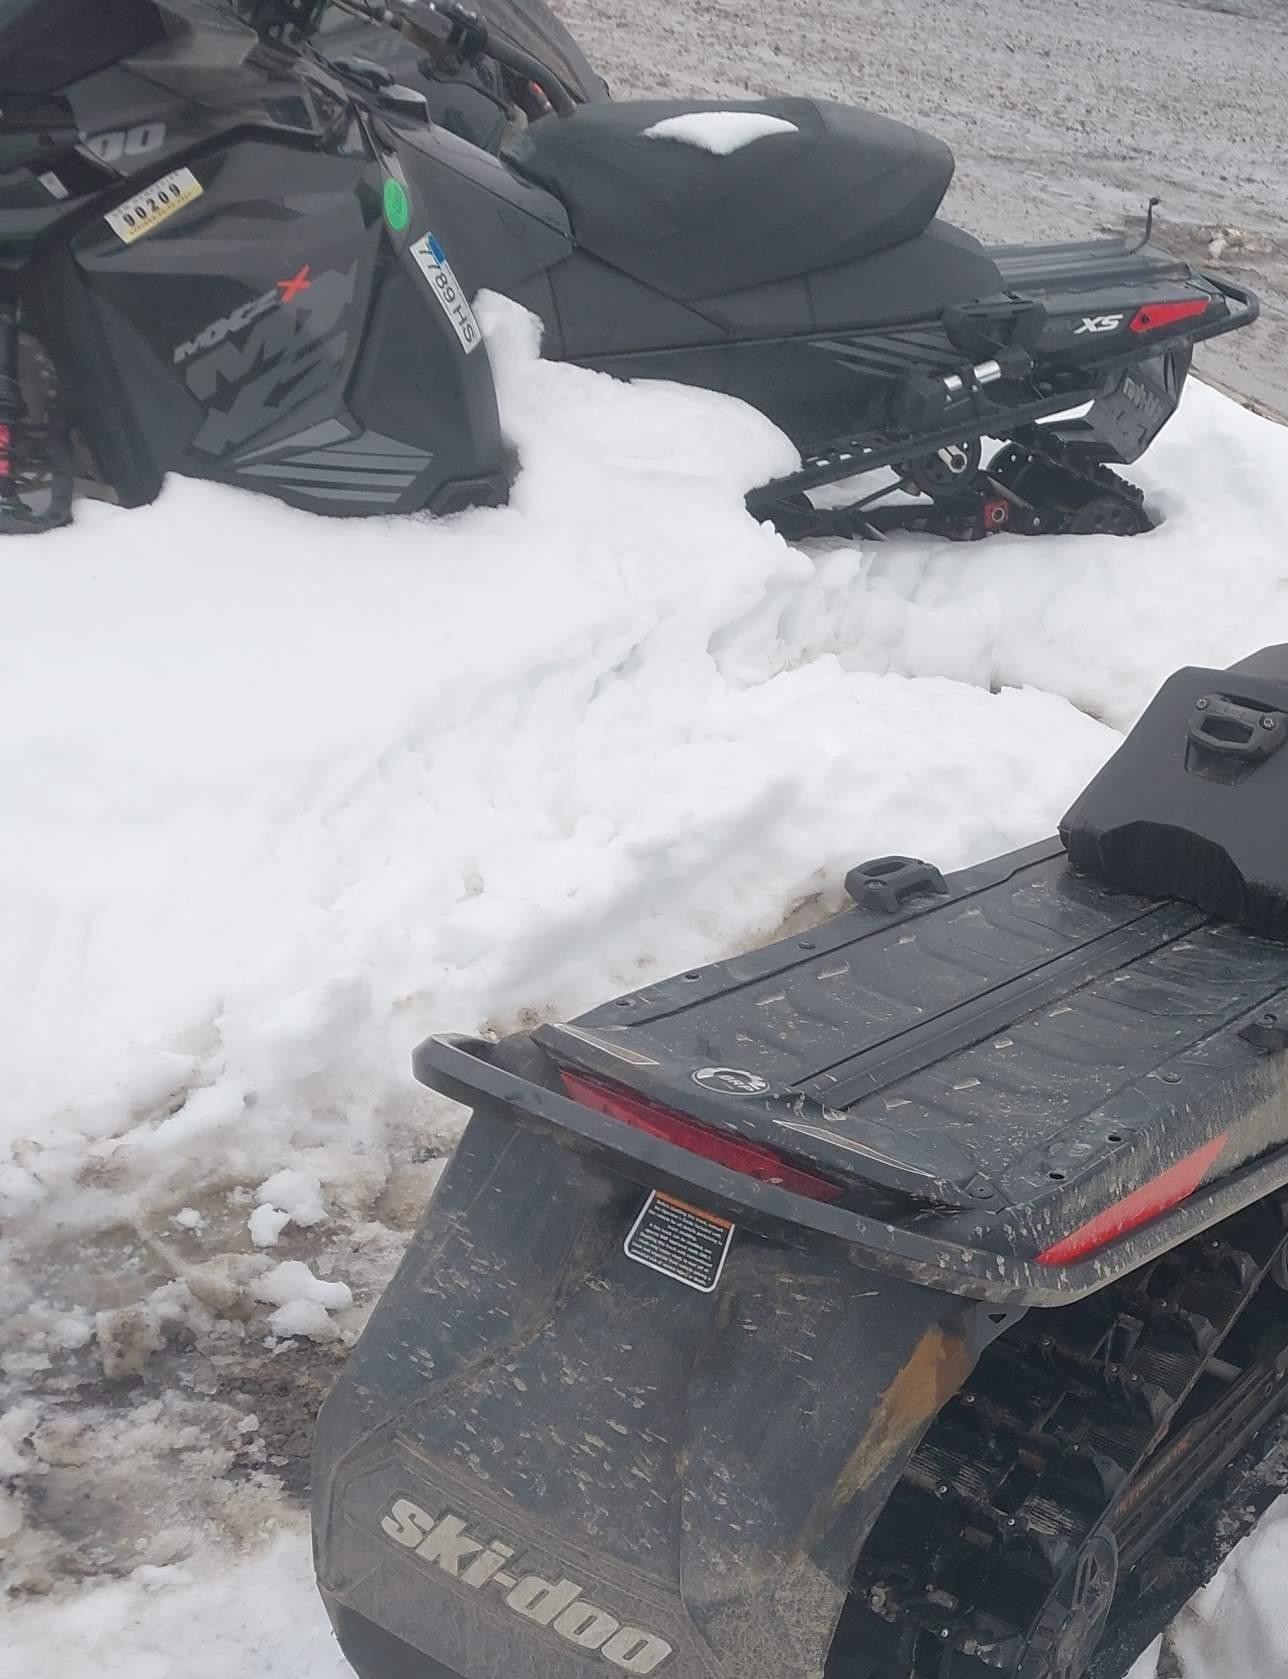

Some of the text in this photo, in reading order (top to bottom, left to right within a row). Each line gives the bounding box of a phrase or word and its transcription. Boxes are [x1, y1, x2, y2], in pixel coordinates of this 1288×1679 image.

[452, 304, 475, 342] HS
[1074, 314, 1123, 334] XS
[718, 1074, 755, 1092] BRP
[381, 1499, 673, 1675] ski-doo
